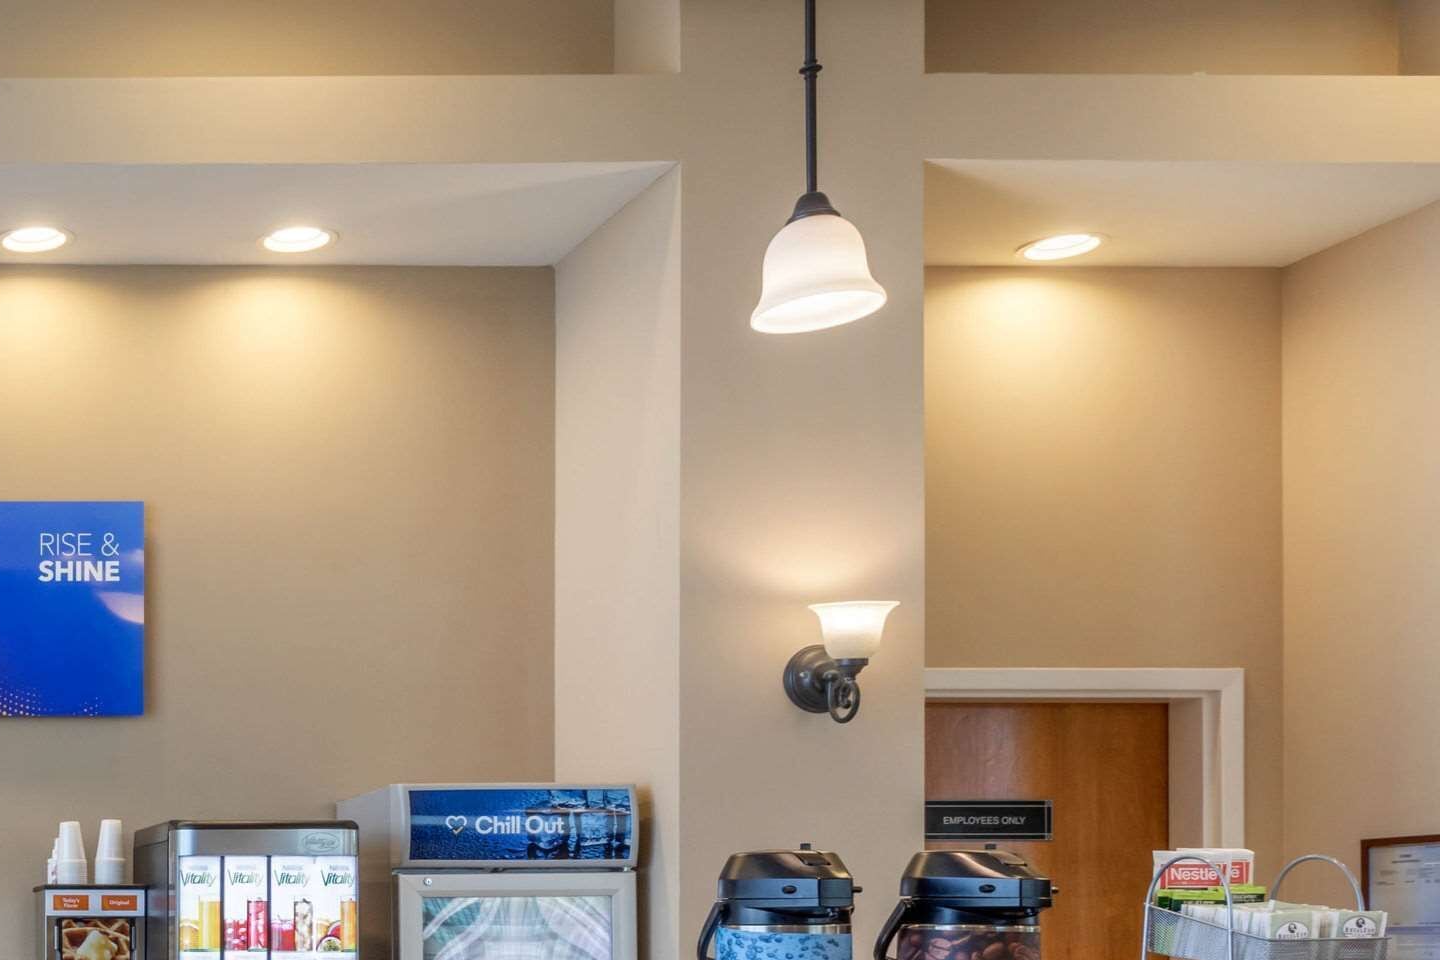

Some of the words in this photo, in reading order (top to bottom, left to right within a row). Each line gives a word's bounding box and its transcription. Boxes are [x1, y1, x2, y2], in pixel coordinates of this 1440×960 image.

[40, 533, 92, 556] RISE
[101, 533, 120, 556] &
[38, 560, 120, 582] SHINE
[475, 815, 520, 835] Chill
[525, 815, 565, 834] Out
[943, 816, 1000, 825] EMPLOYEES
[1001, 816, 1026, 825] ONLY
[180, 869, 216, 887] Vitality
[227, 869, 264, 887] Vitality
[274, 869, 311, 887] Vitality
[321, 869, 355, 887] Vitality
